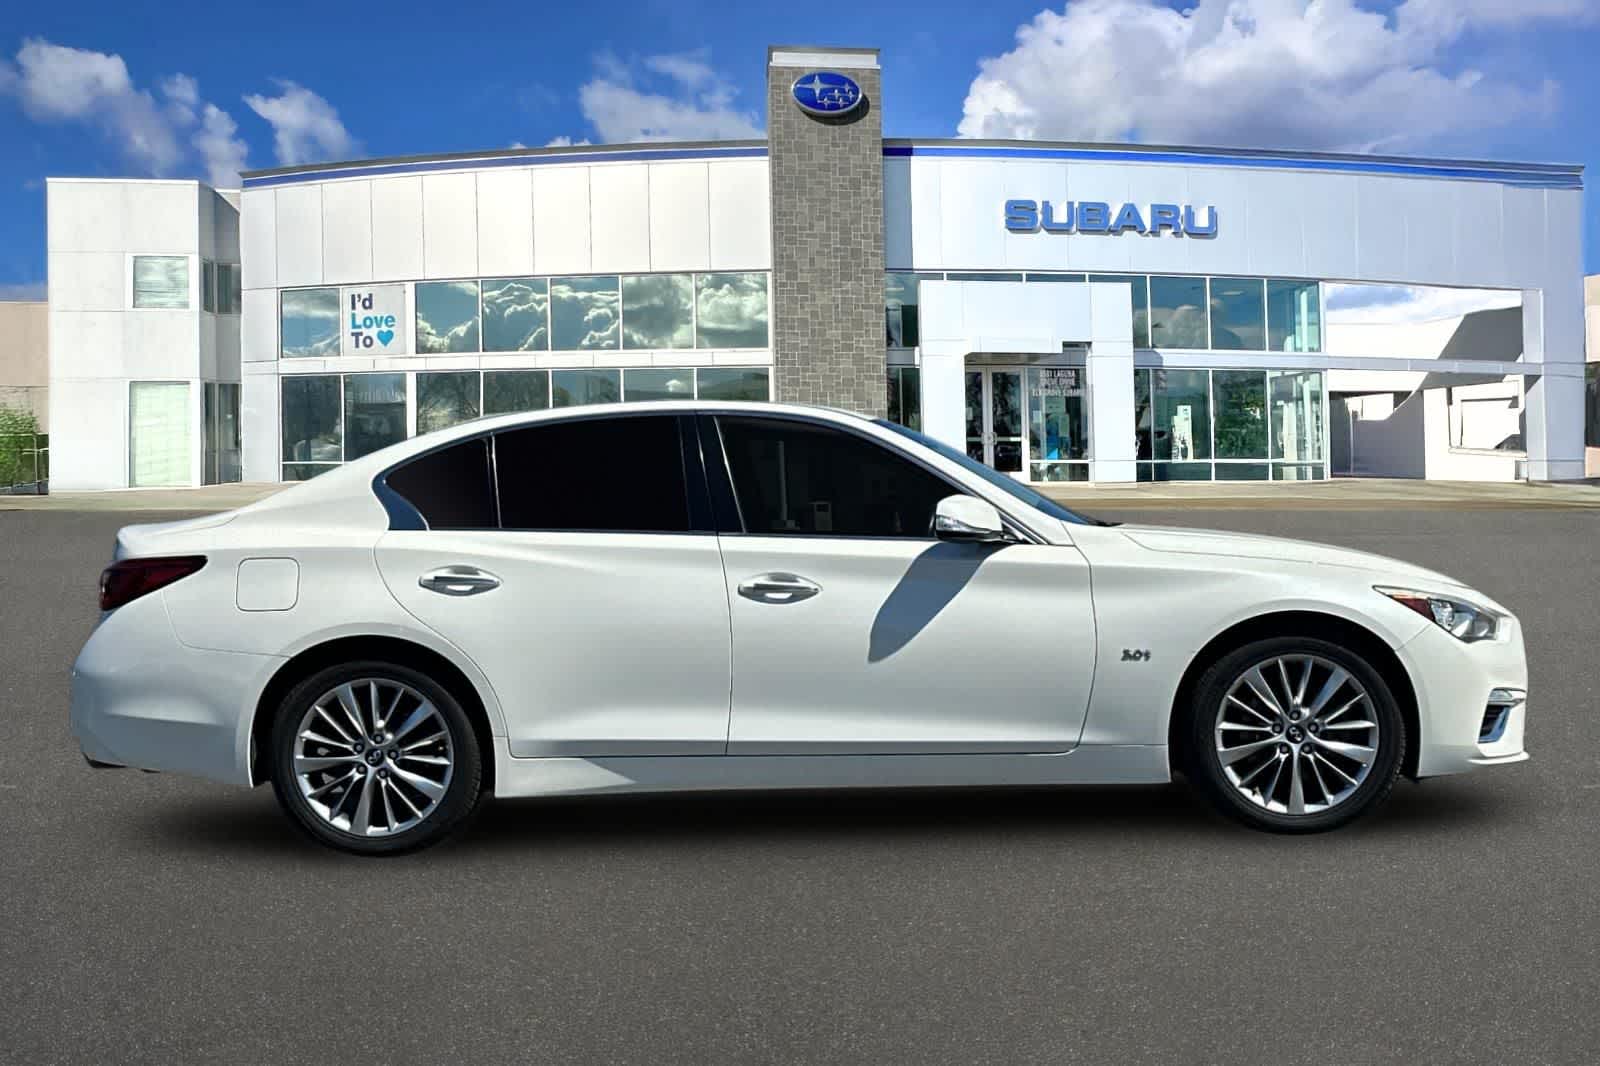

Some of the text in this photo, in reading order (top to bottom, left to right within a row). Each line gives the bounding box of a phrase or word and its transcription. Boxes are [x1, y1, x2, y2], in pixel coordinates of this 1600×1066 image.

[1005, 199, 1217, 239] SUBARU
[351, 312, 396, 330] Love
[351, 331, 374, 349] To
